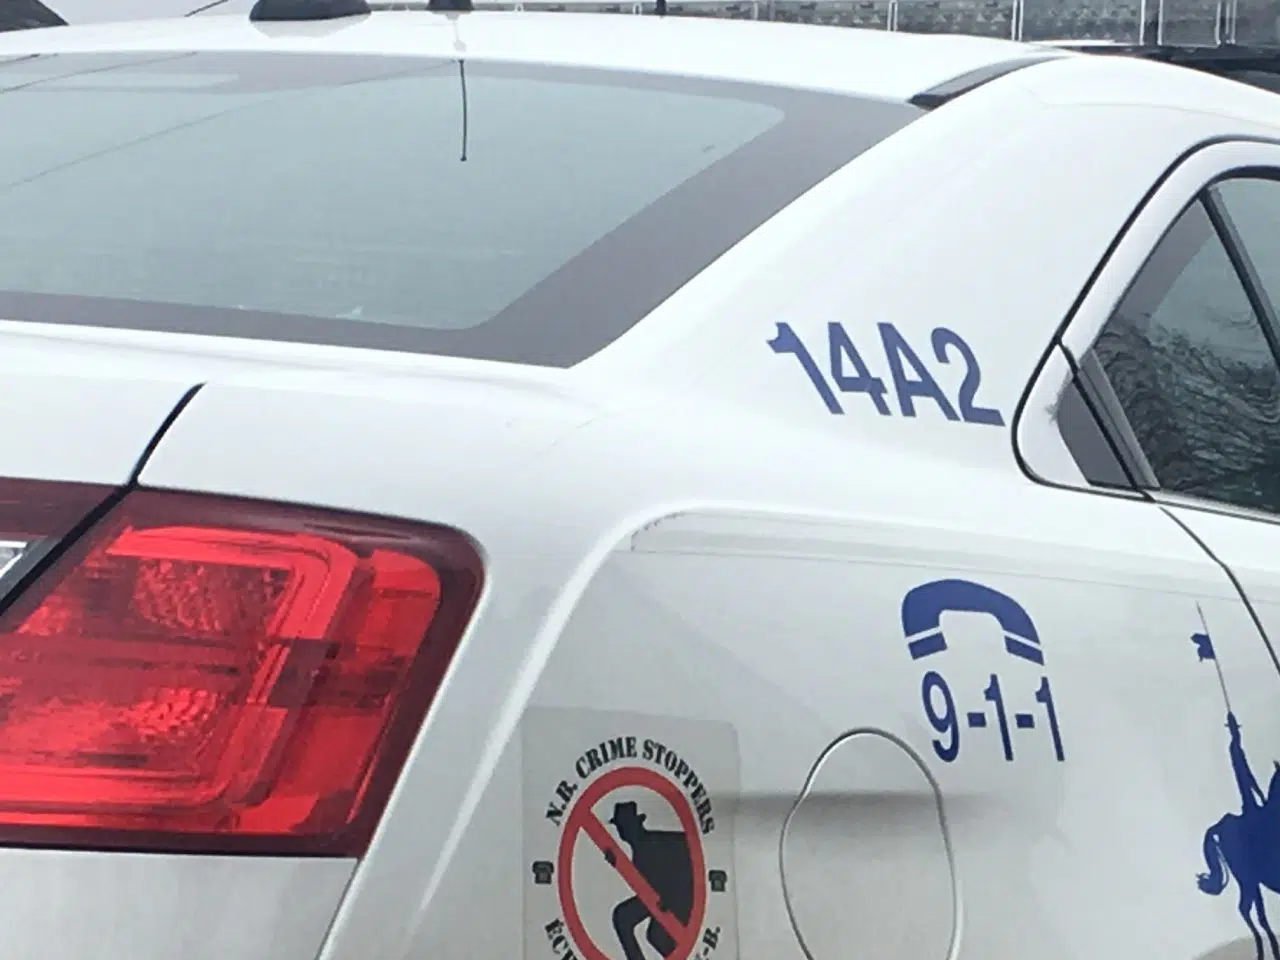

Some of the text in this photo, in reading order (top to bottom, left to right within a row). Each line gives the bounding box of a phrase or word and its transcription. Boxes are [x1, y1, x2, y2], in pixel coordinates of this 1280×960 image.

[766, 321, 1006, 427] 14A2
[921, 671, 1065, 763] 9-1-1
[545, 736, 716, 835] N.B. CRIME STOPPERS
